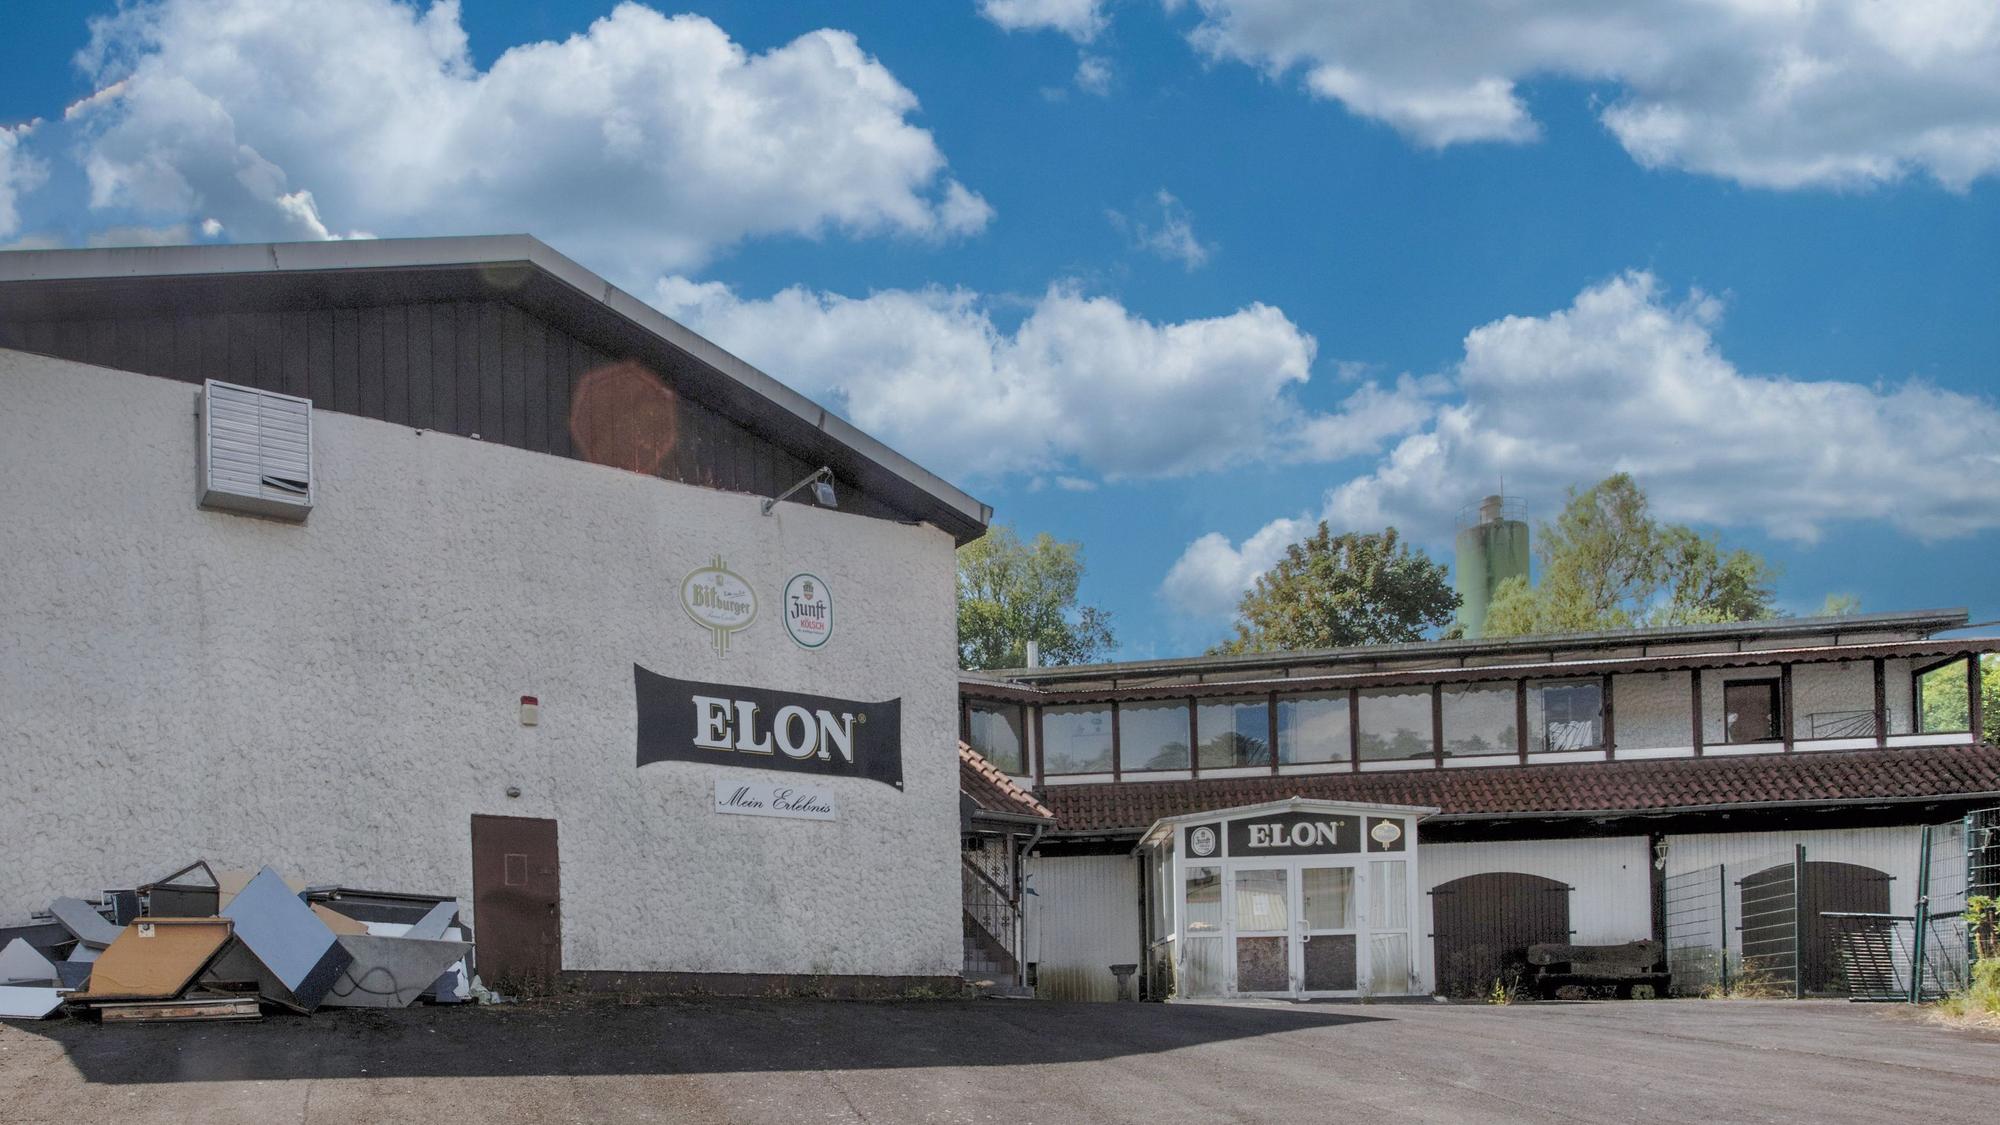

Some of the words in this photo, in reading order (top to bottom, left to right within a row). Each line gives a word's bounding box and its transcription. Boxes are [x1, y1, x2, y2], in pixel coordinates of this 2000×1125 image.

[692, 583, 751, 616] Bitburger
[791, 596, 826, 619] Zunft
[801, 618, 825, 630] KÖLSCH
[719, 786, 764, 809] Mein
[772, 788, 831, 814] Erlebnis
